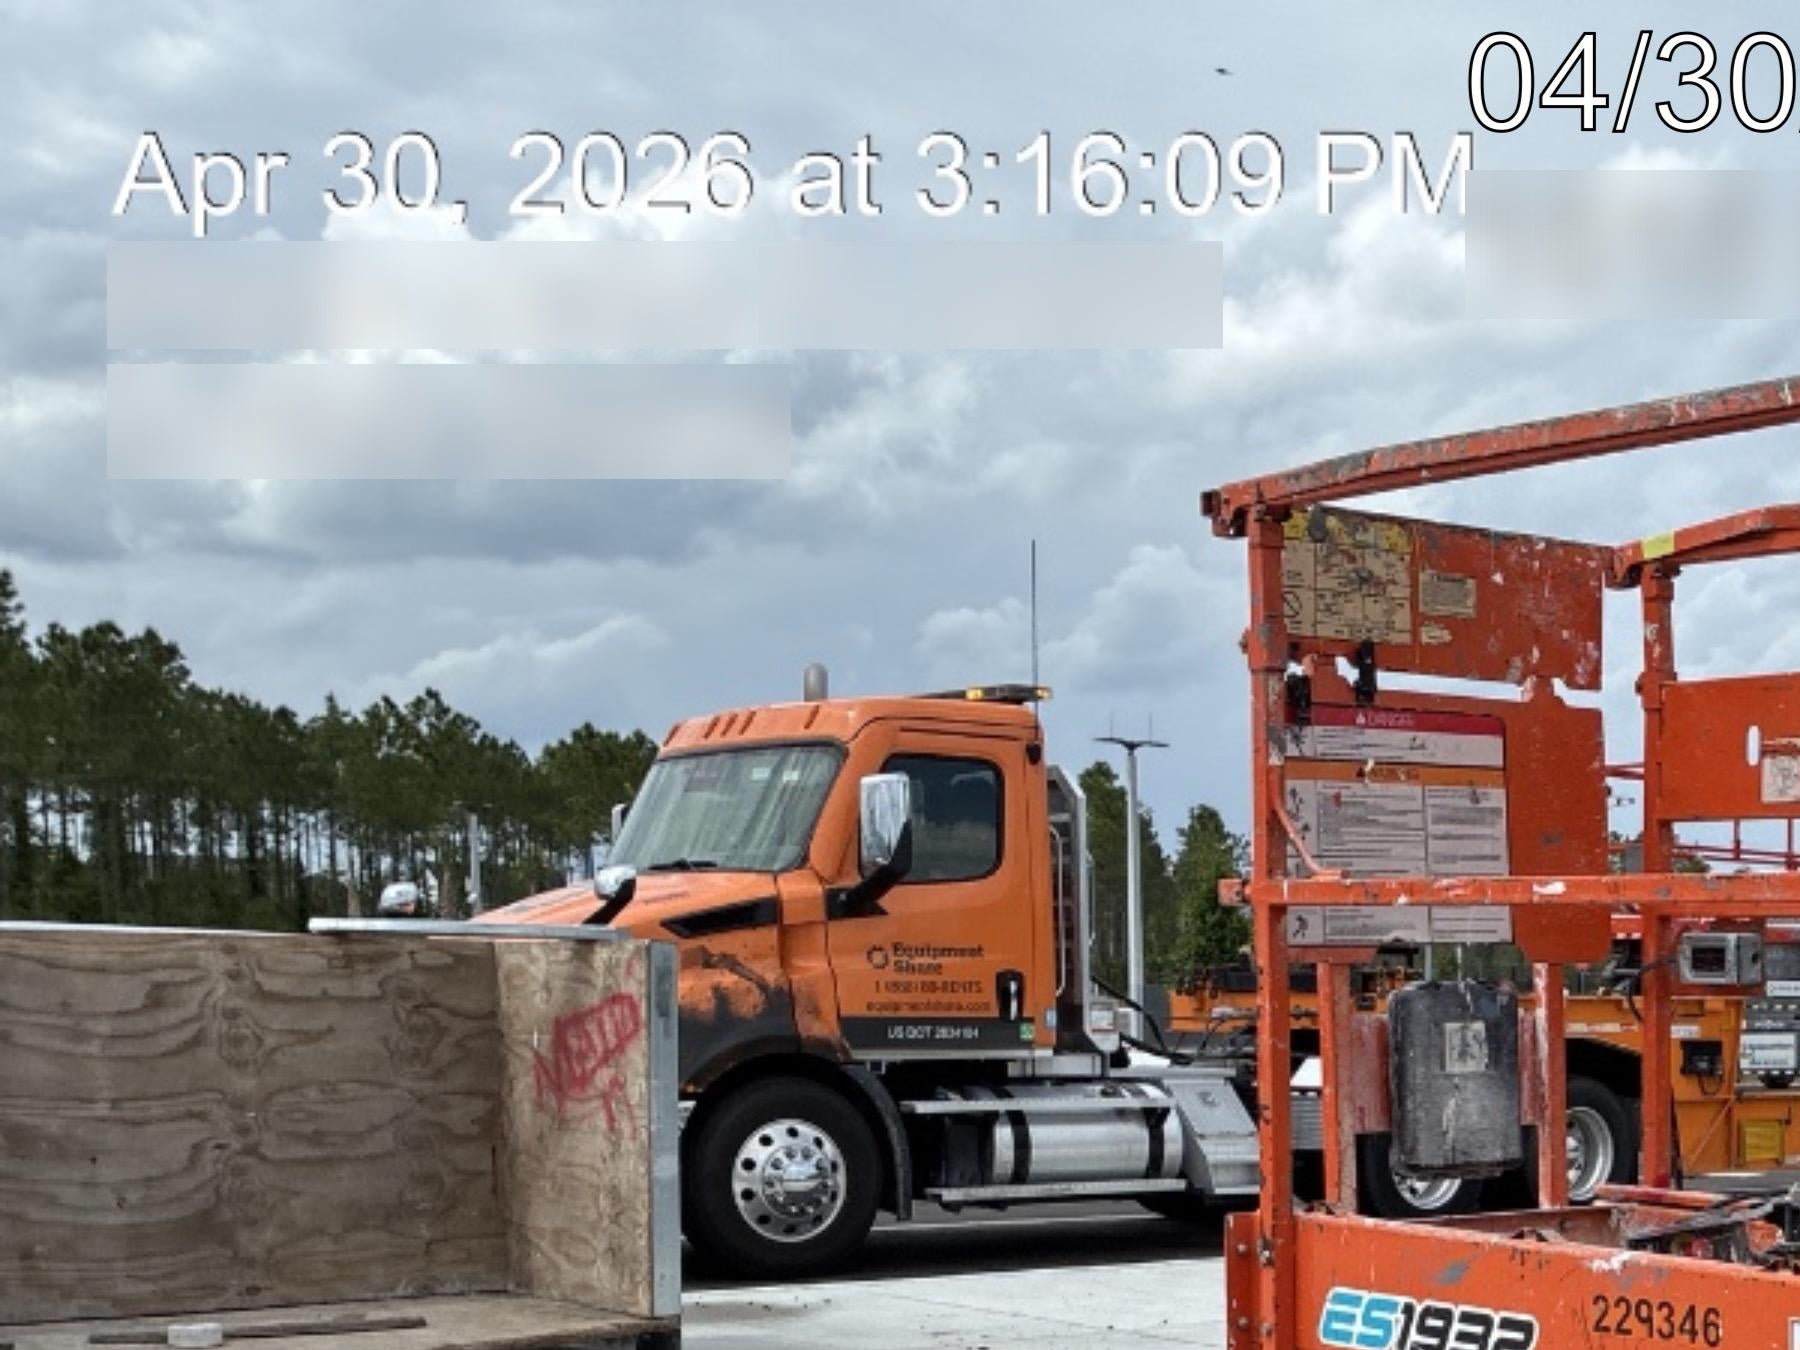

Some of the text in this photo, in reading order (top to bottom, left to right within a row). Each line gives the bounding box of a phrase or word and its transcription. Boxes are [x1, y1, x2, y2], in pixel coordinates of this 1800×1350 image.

[893, 942, 985, 960] Equipment
[893, 960, 943, 976] Share
[1590, 1294, 1723, 1348] 229346
